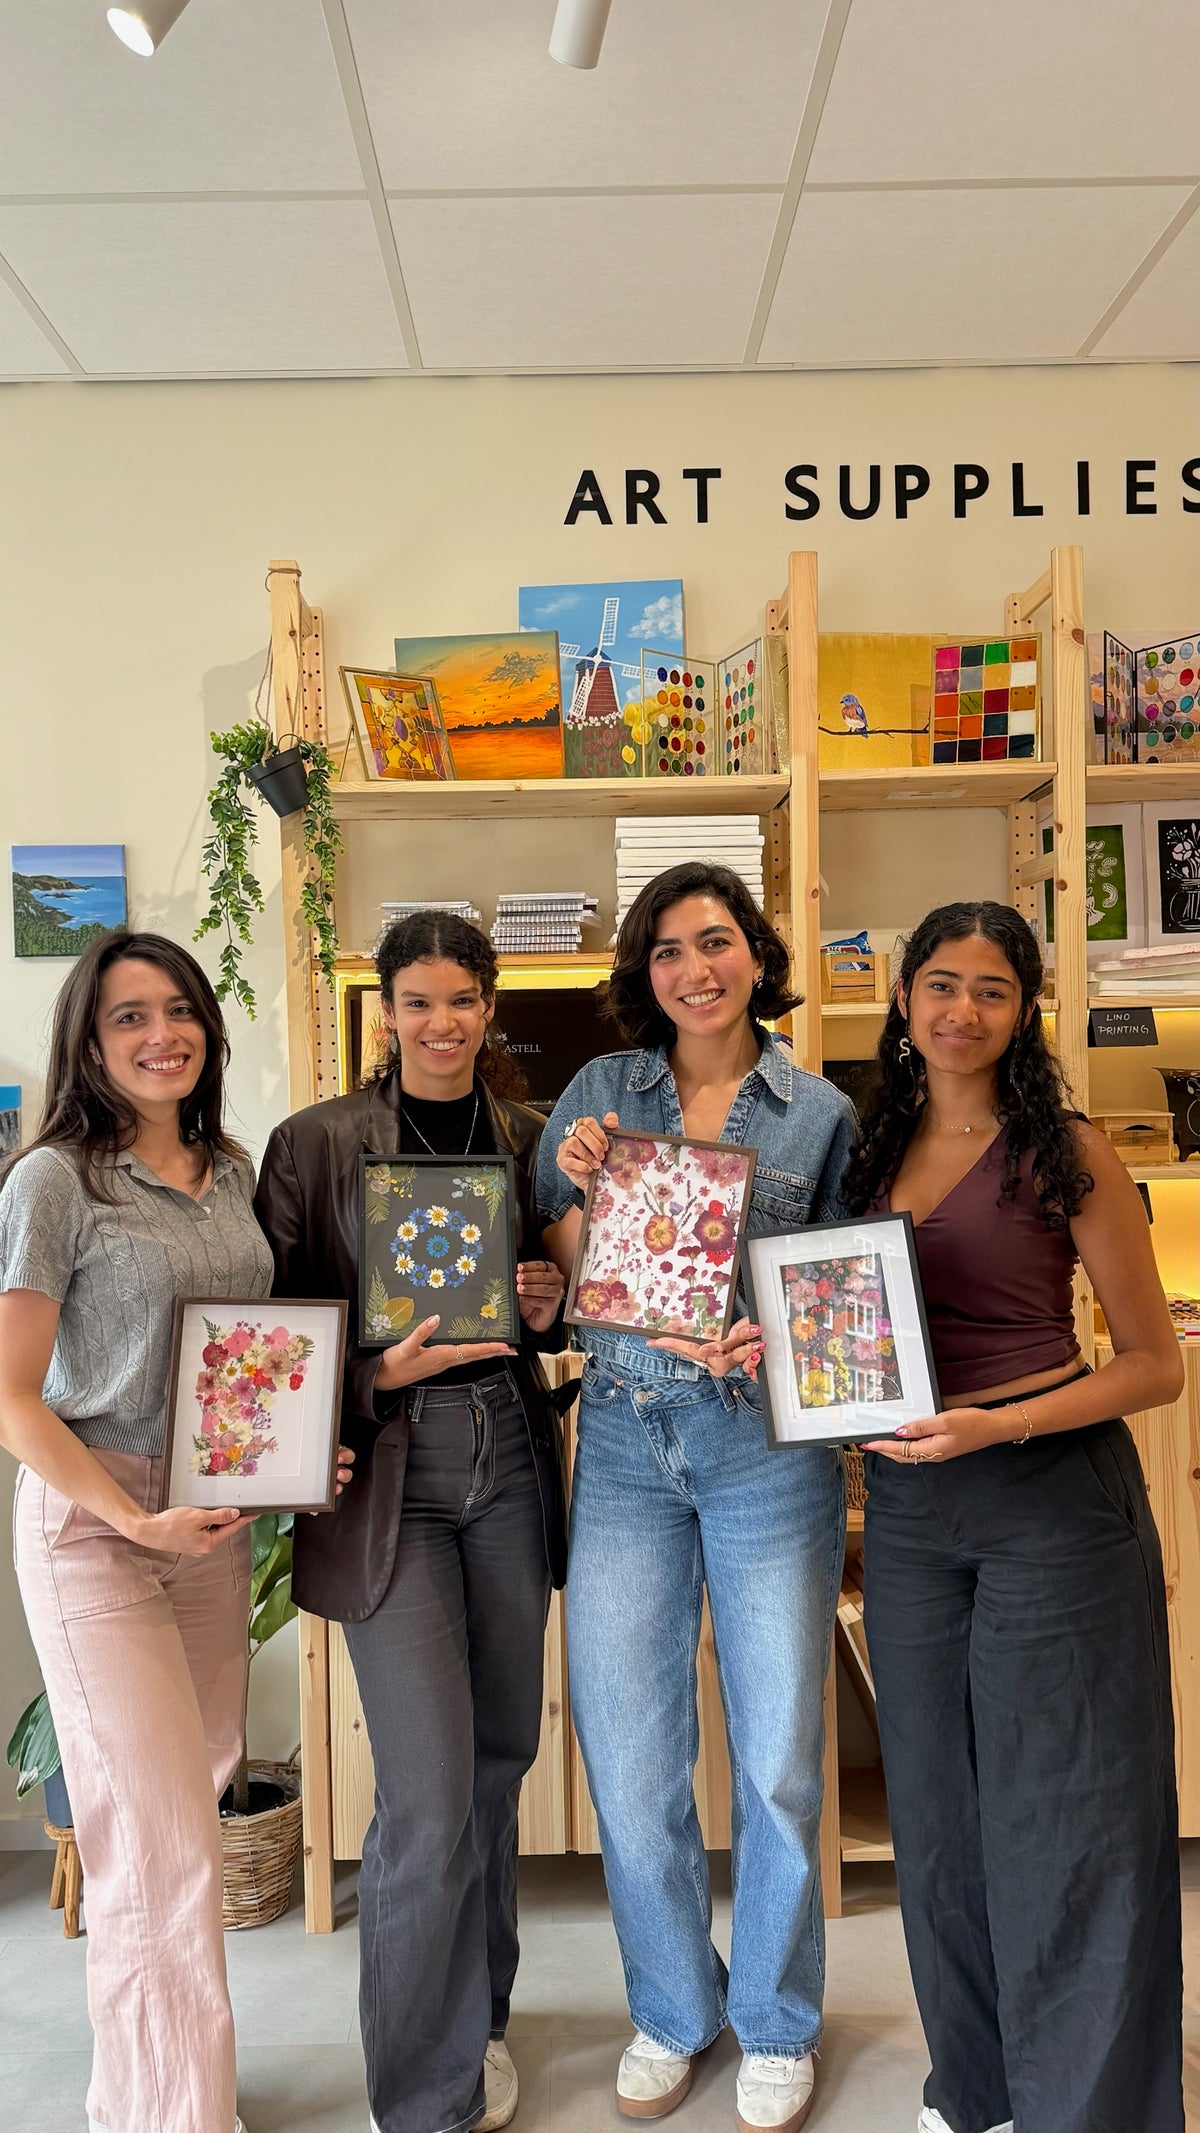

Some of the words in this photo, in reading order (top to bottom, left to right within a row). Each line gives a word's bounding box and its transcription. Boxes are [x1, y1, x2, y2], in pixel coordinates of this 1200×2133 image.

[563, 467, 722, 525] ART
[784, 457, 1200, 521] SUPPLIES
[1106, 1013, 1130, 1022] LINO
[1098, 1024, 1149, 1035] PRINTING
[503, 1044, 542, 1053] ASTELL
